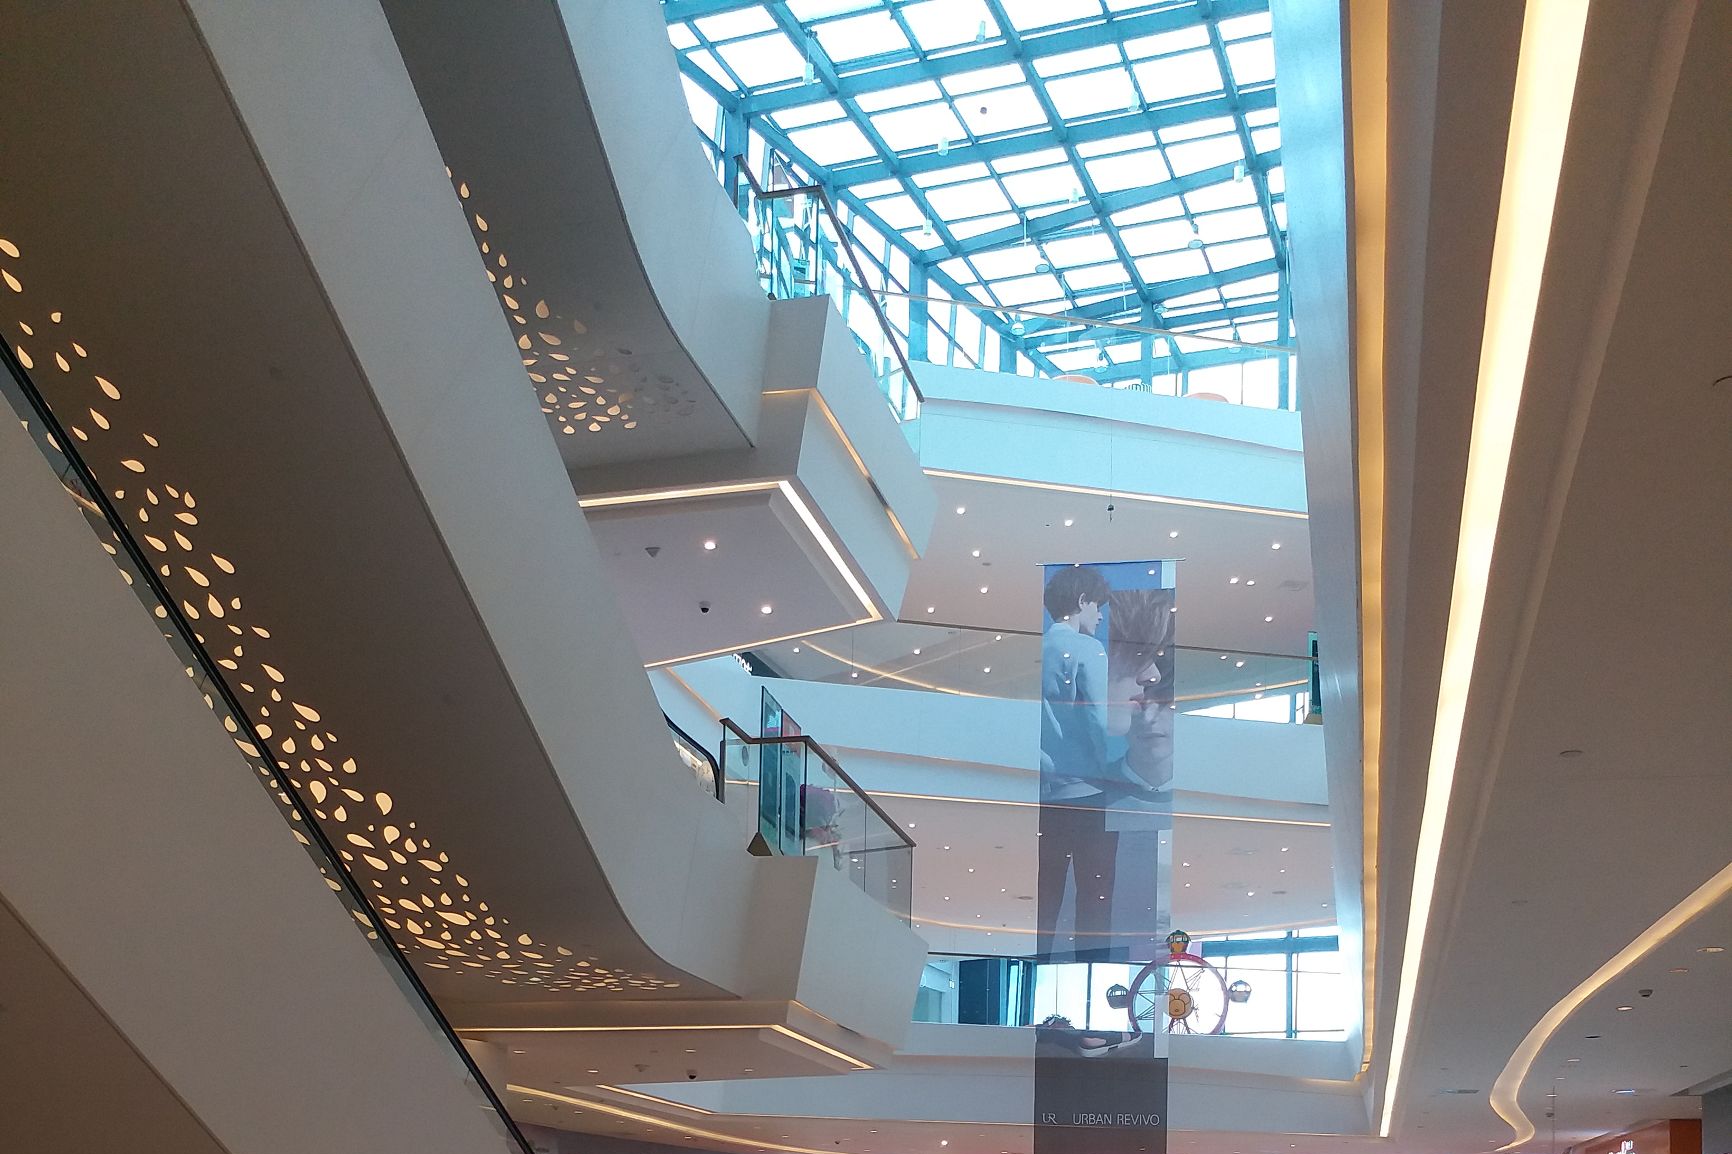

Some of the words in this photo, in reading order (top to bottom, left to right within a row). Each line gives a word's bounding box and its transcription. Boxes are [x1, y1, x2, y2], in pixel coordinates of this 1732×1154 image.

[1042, 1112, 1058, 1125] UR
[1072, 1113, 1112, 1125] URBAN
[1117, 1113, 1160, 1126] REVIVO
